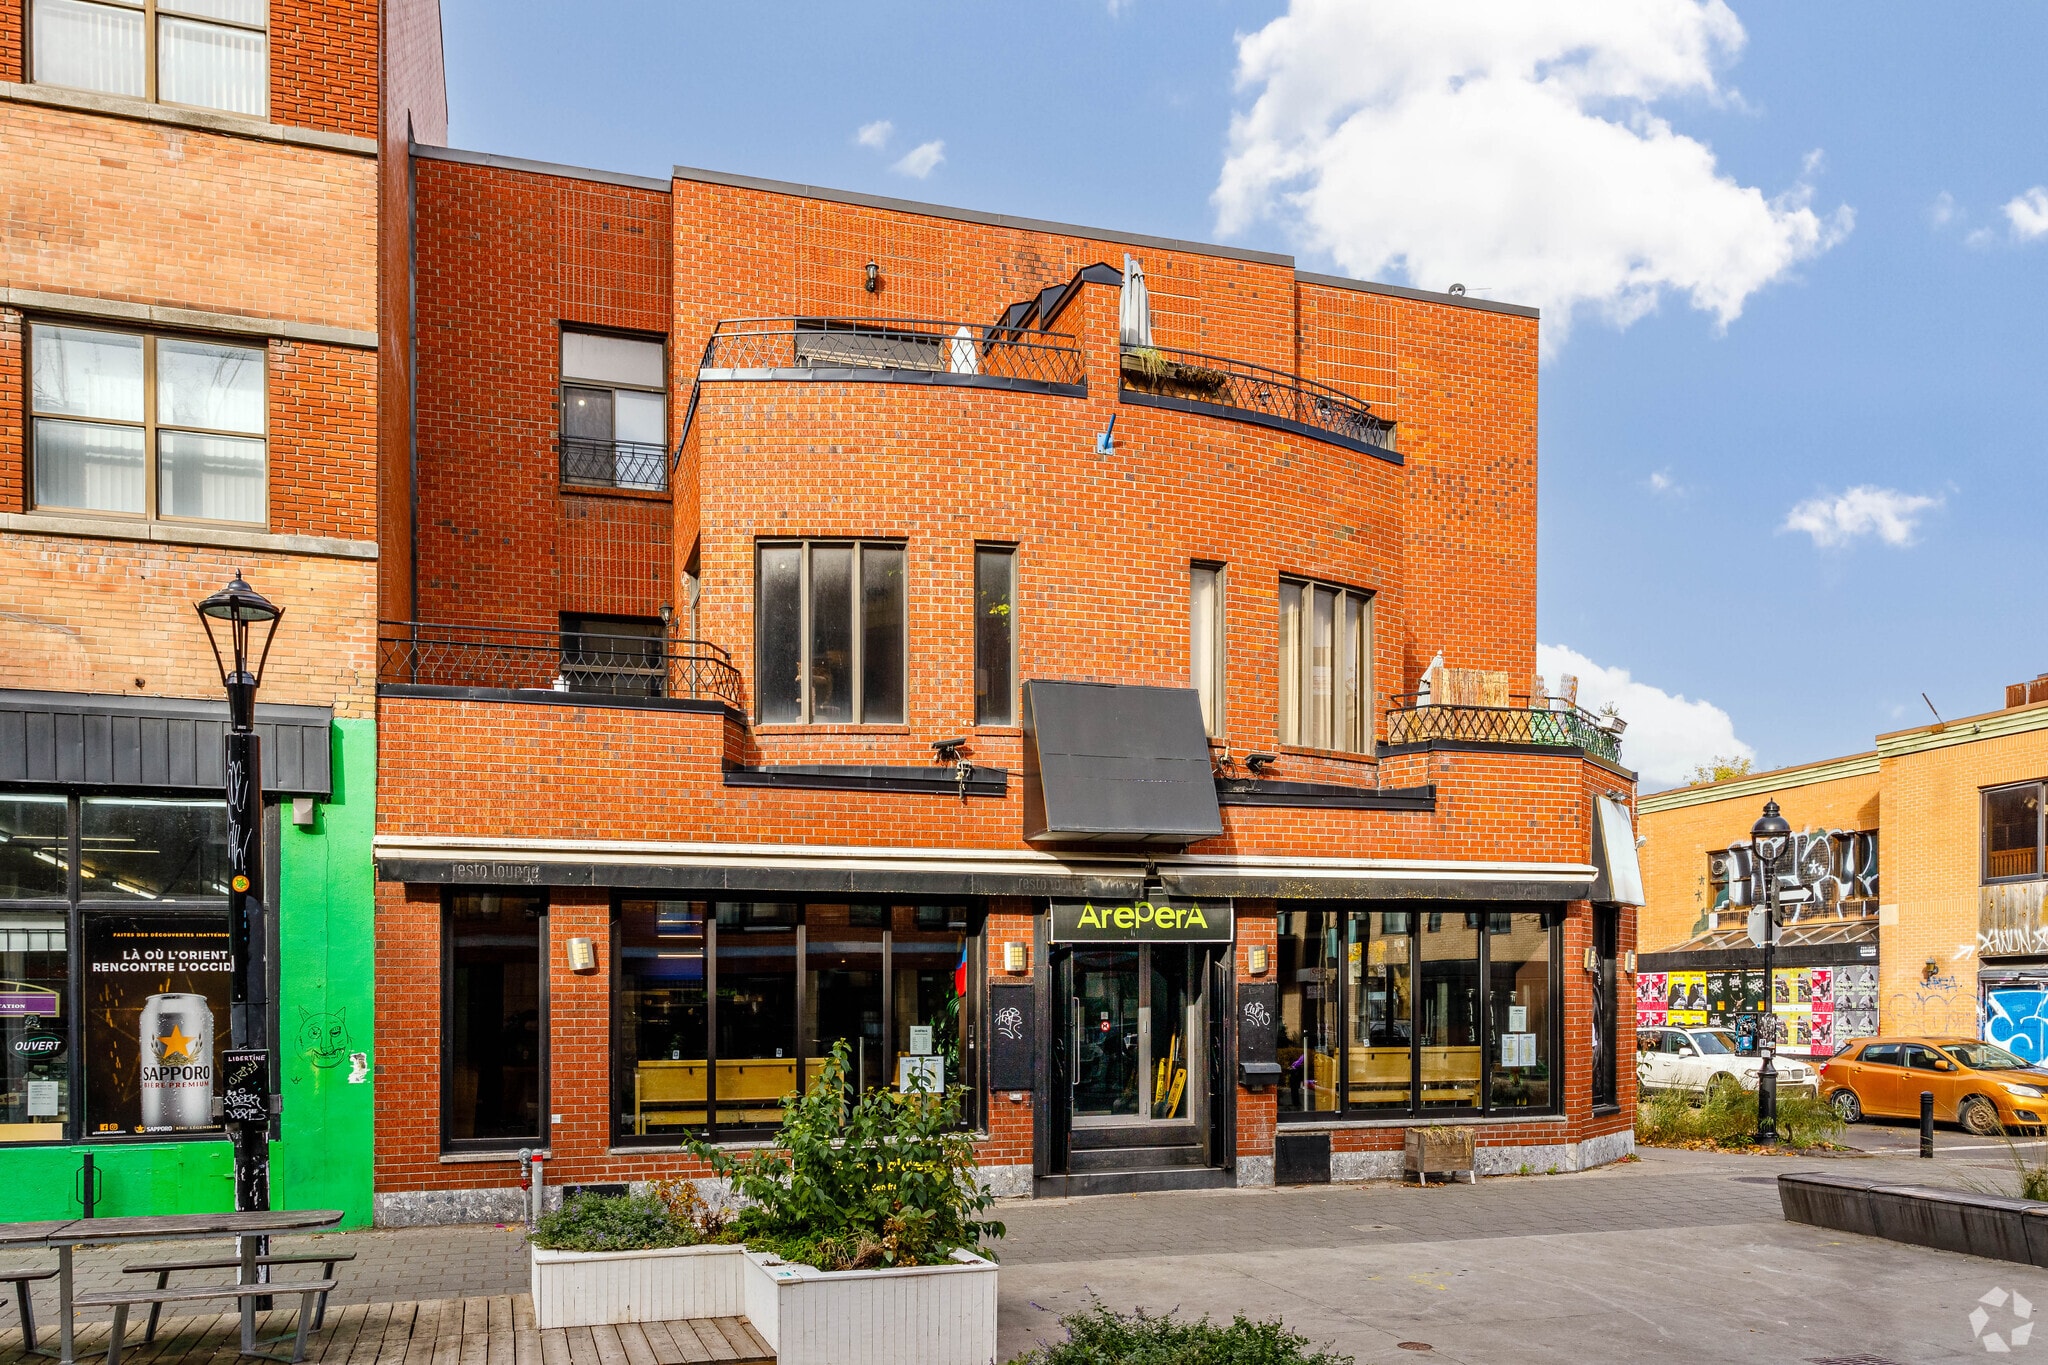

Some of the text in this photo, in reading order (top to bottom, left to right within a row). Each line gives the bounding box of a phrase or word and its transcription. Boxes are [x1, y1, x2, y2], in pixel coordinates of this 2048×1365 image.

[452, 860, 540, 882] resto lounge
[123, 948, 228, 960] LÀ OÙ L'ORIENT
[92, 962, 175, 972] RENCONTRE
[15, 1041, 61, 1051] OUVERT
[228, 1054, 266, 1062] LIBERTINE
[143, 1065, 210, 1080] SAPPORO
[168, 1080, 209, 1088] PREMIUM
